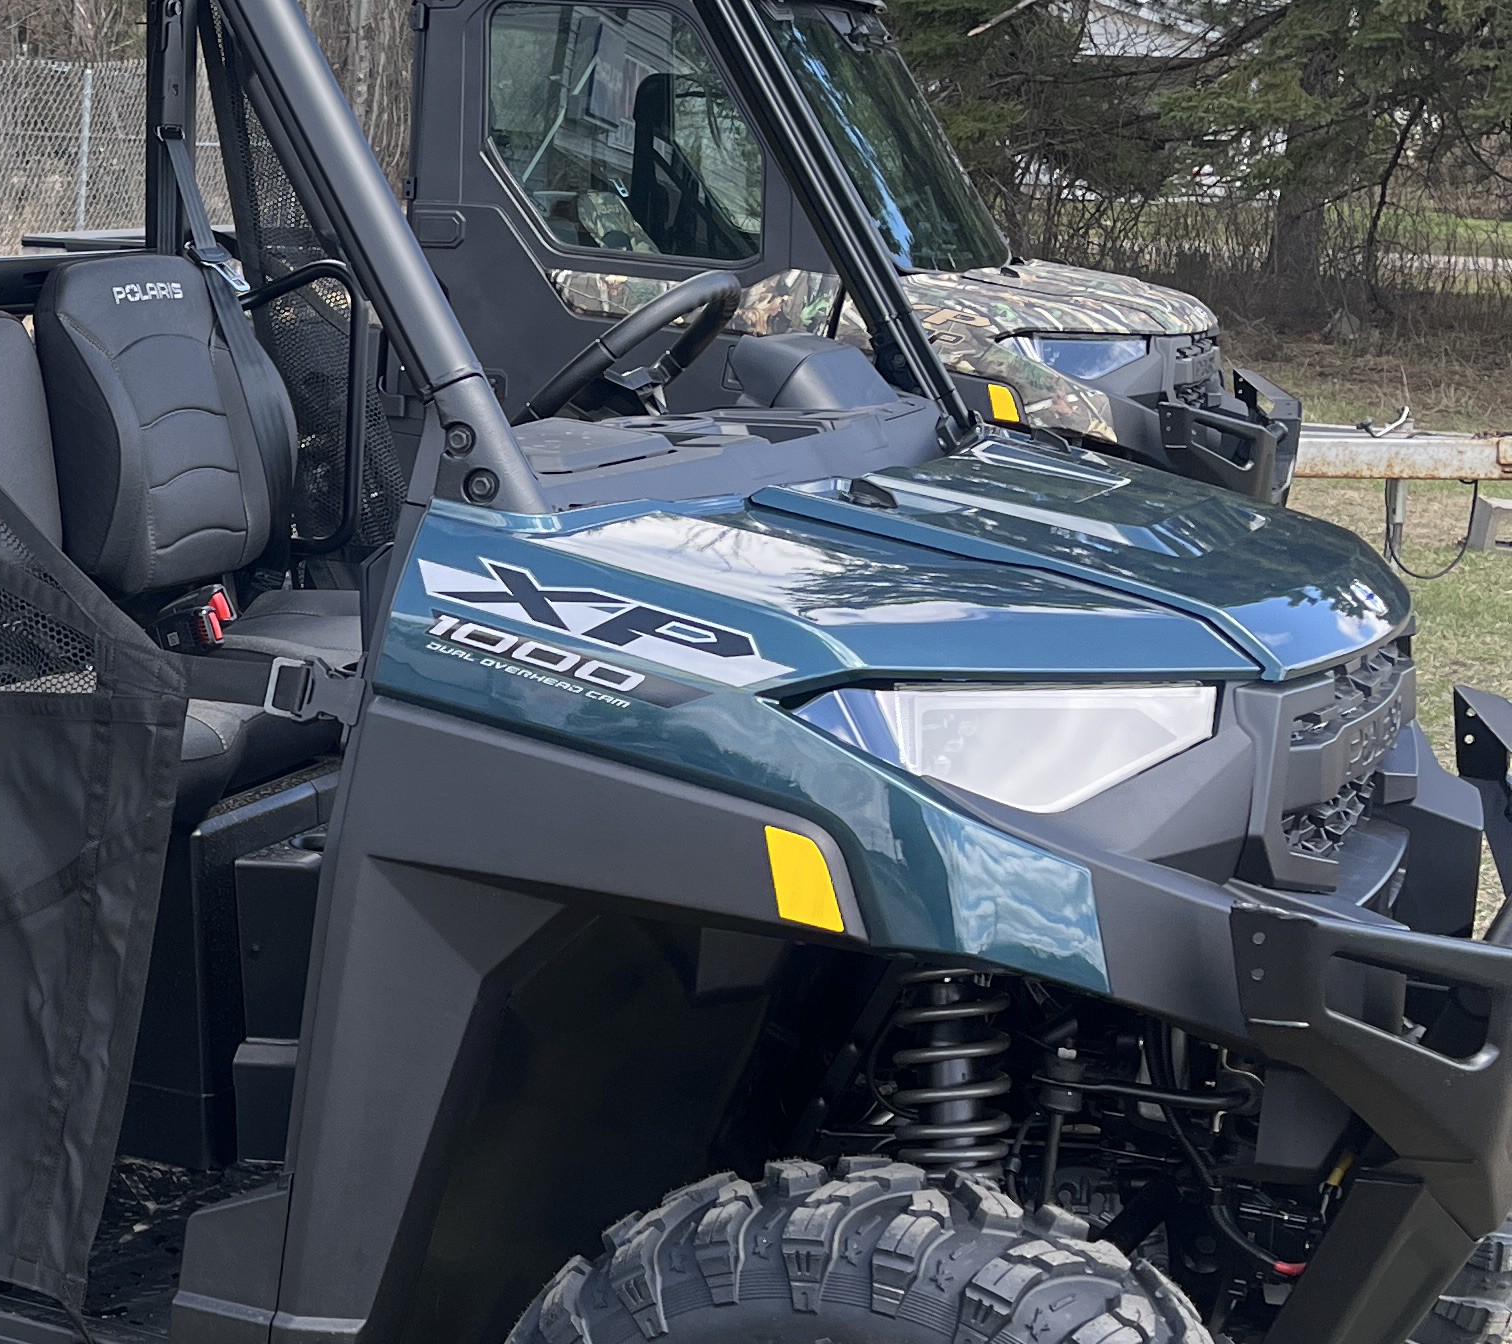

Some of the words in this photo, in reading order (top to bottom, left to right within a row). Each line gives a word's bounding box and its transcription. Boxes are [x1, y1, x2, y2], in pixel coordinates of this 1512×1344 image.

[112, 282, 184, 305] POLARIS
[420, 554, 770, 664] XP
[425, 640, 476, 663] DUAL
[478, 656, 585, 695] OVERHEAD
[584, 688, 632, 710] CAM
[427, 613, 646, 693] 1000
